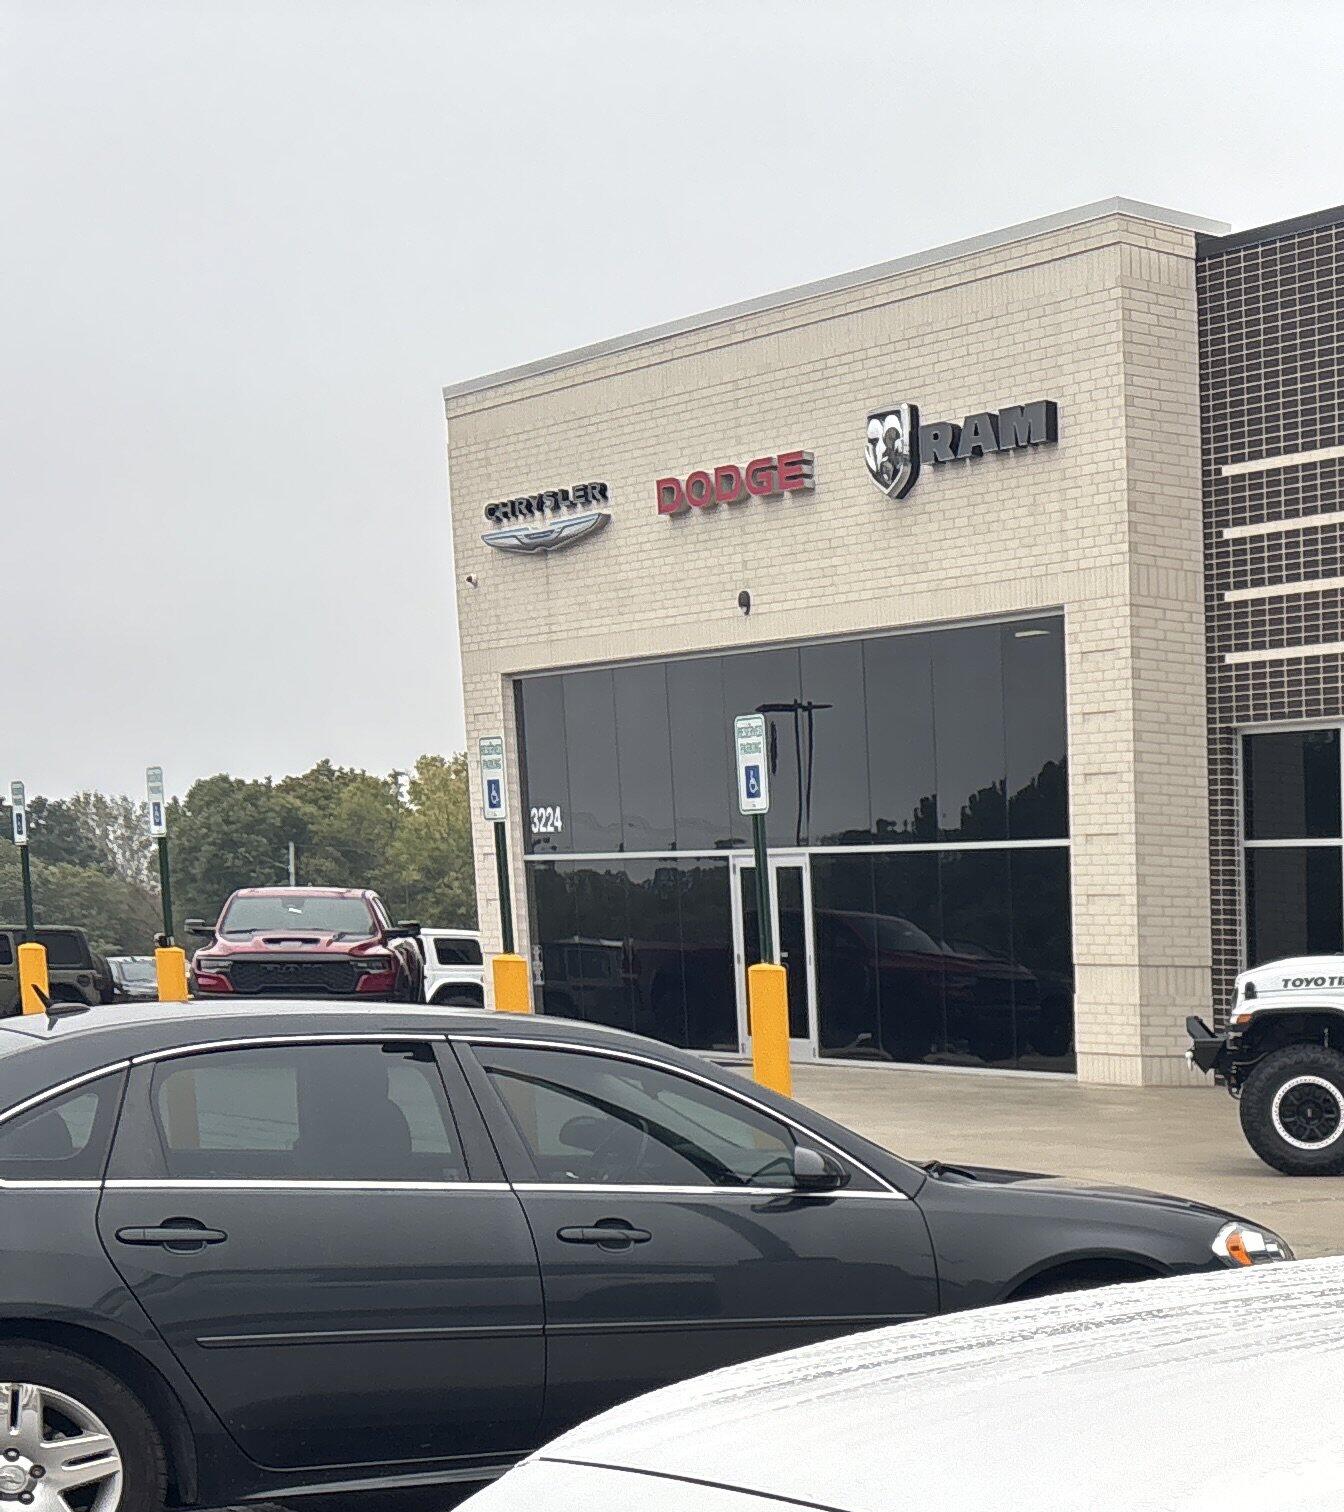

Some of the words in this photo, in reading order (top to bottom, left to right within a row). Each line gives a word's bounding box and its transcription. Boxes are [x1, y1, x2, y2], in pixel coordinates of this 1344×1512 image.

[919, 400, 1058, 465] RAM
[485, 481, 608, 523] CHRYSLER
[656, 450, 814, 516] DODGE
[530, 806, 562, 833] 3224
[1282, 977, 1326, 989] TOYO
